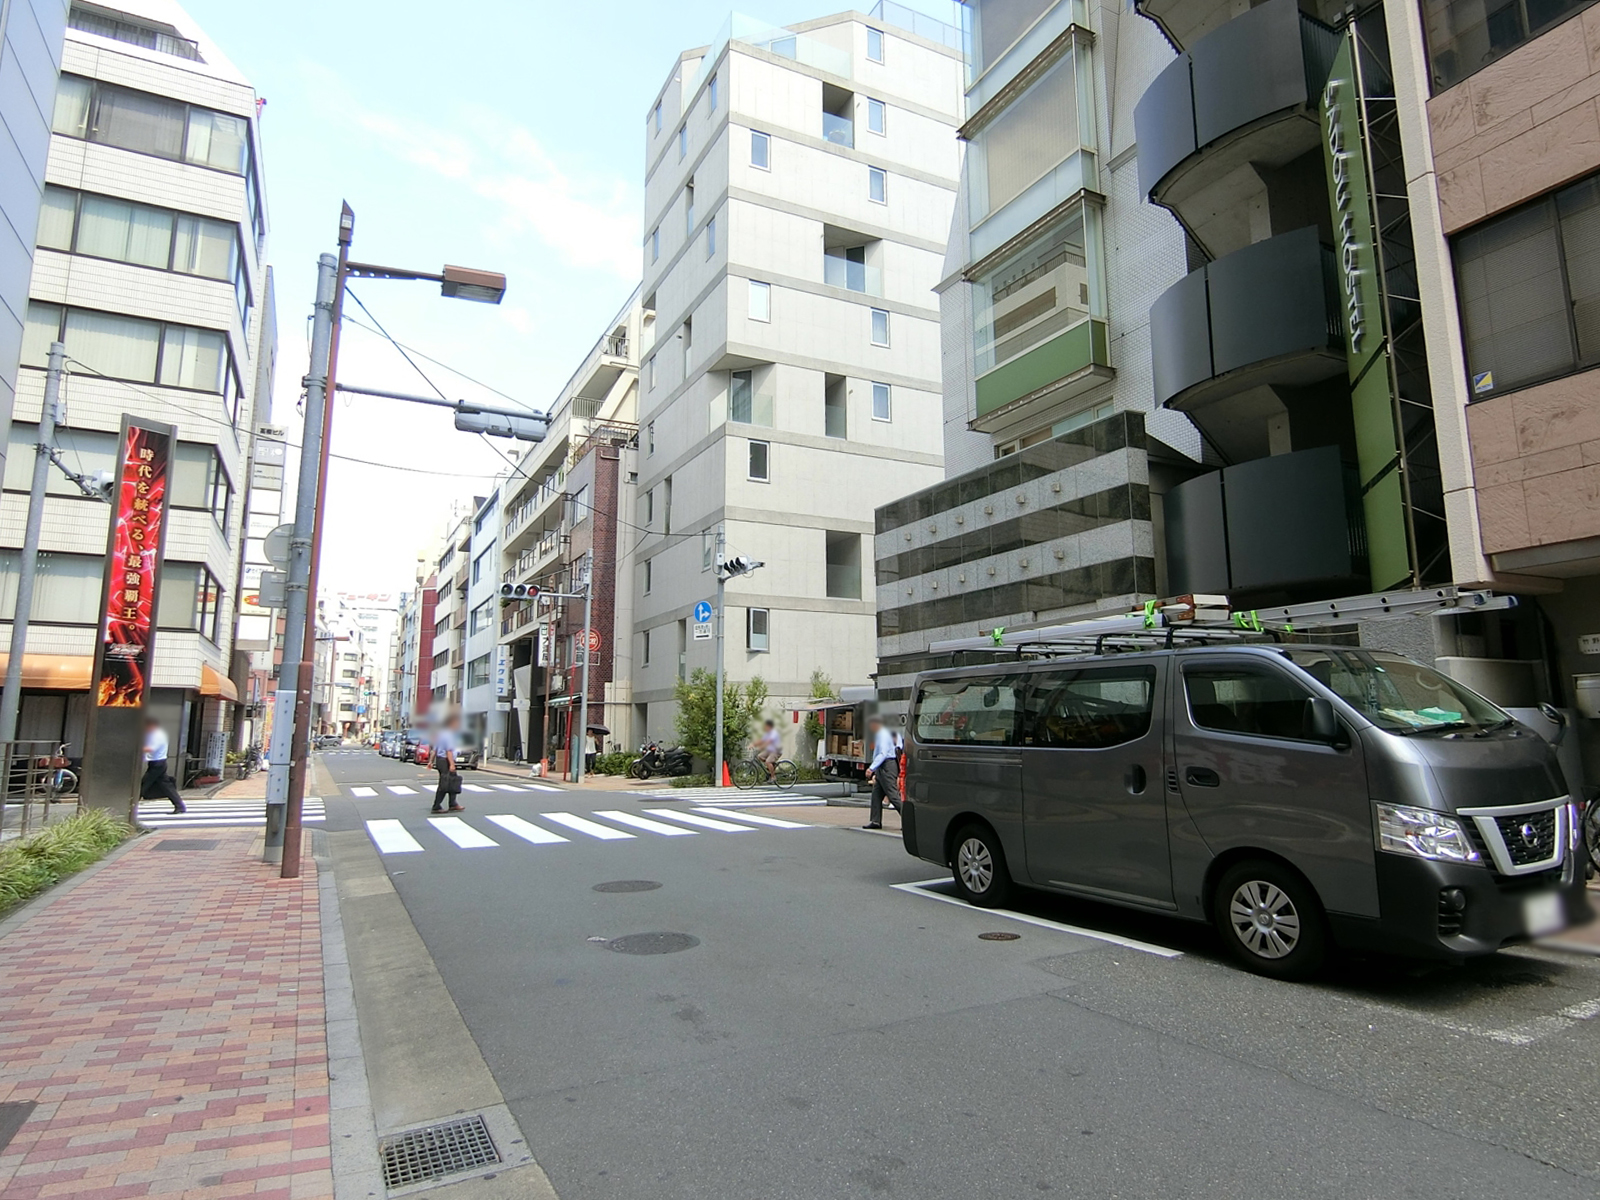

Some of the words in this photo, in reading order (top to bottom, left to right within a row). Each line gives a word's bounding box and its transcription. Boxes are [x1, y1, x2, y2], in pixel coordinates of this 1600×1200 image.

[1323, 79, 1352, 213] SADOU
[1338, 210, 1366, 355] HOSTEL
[919, 713, 944, 725] OSTEL
